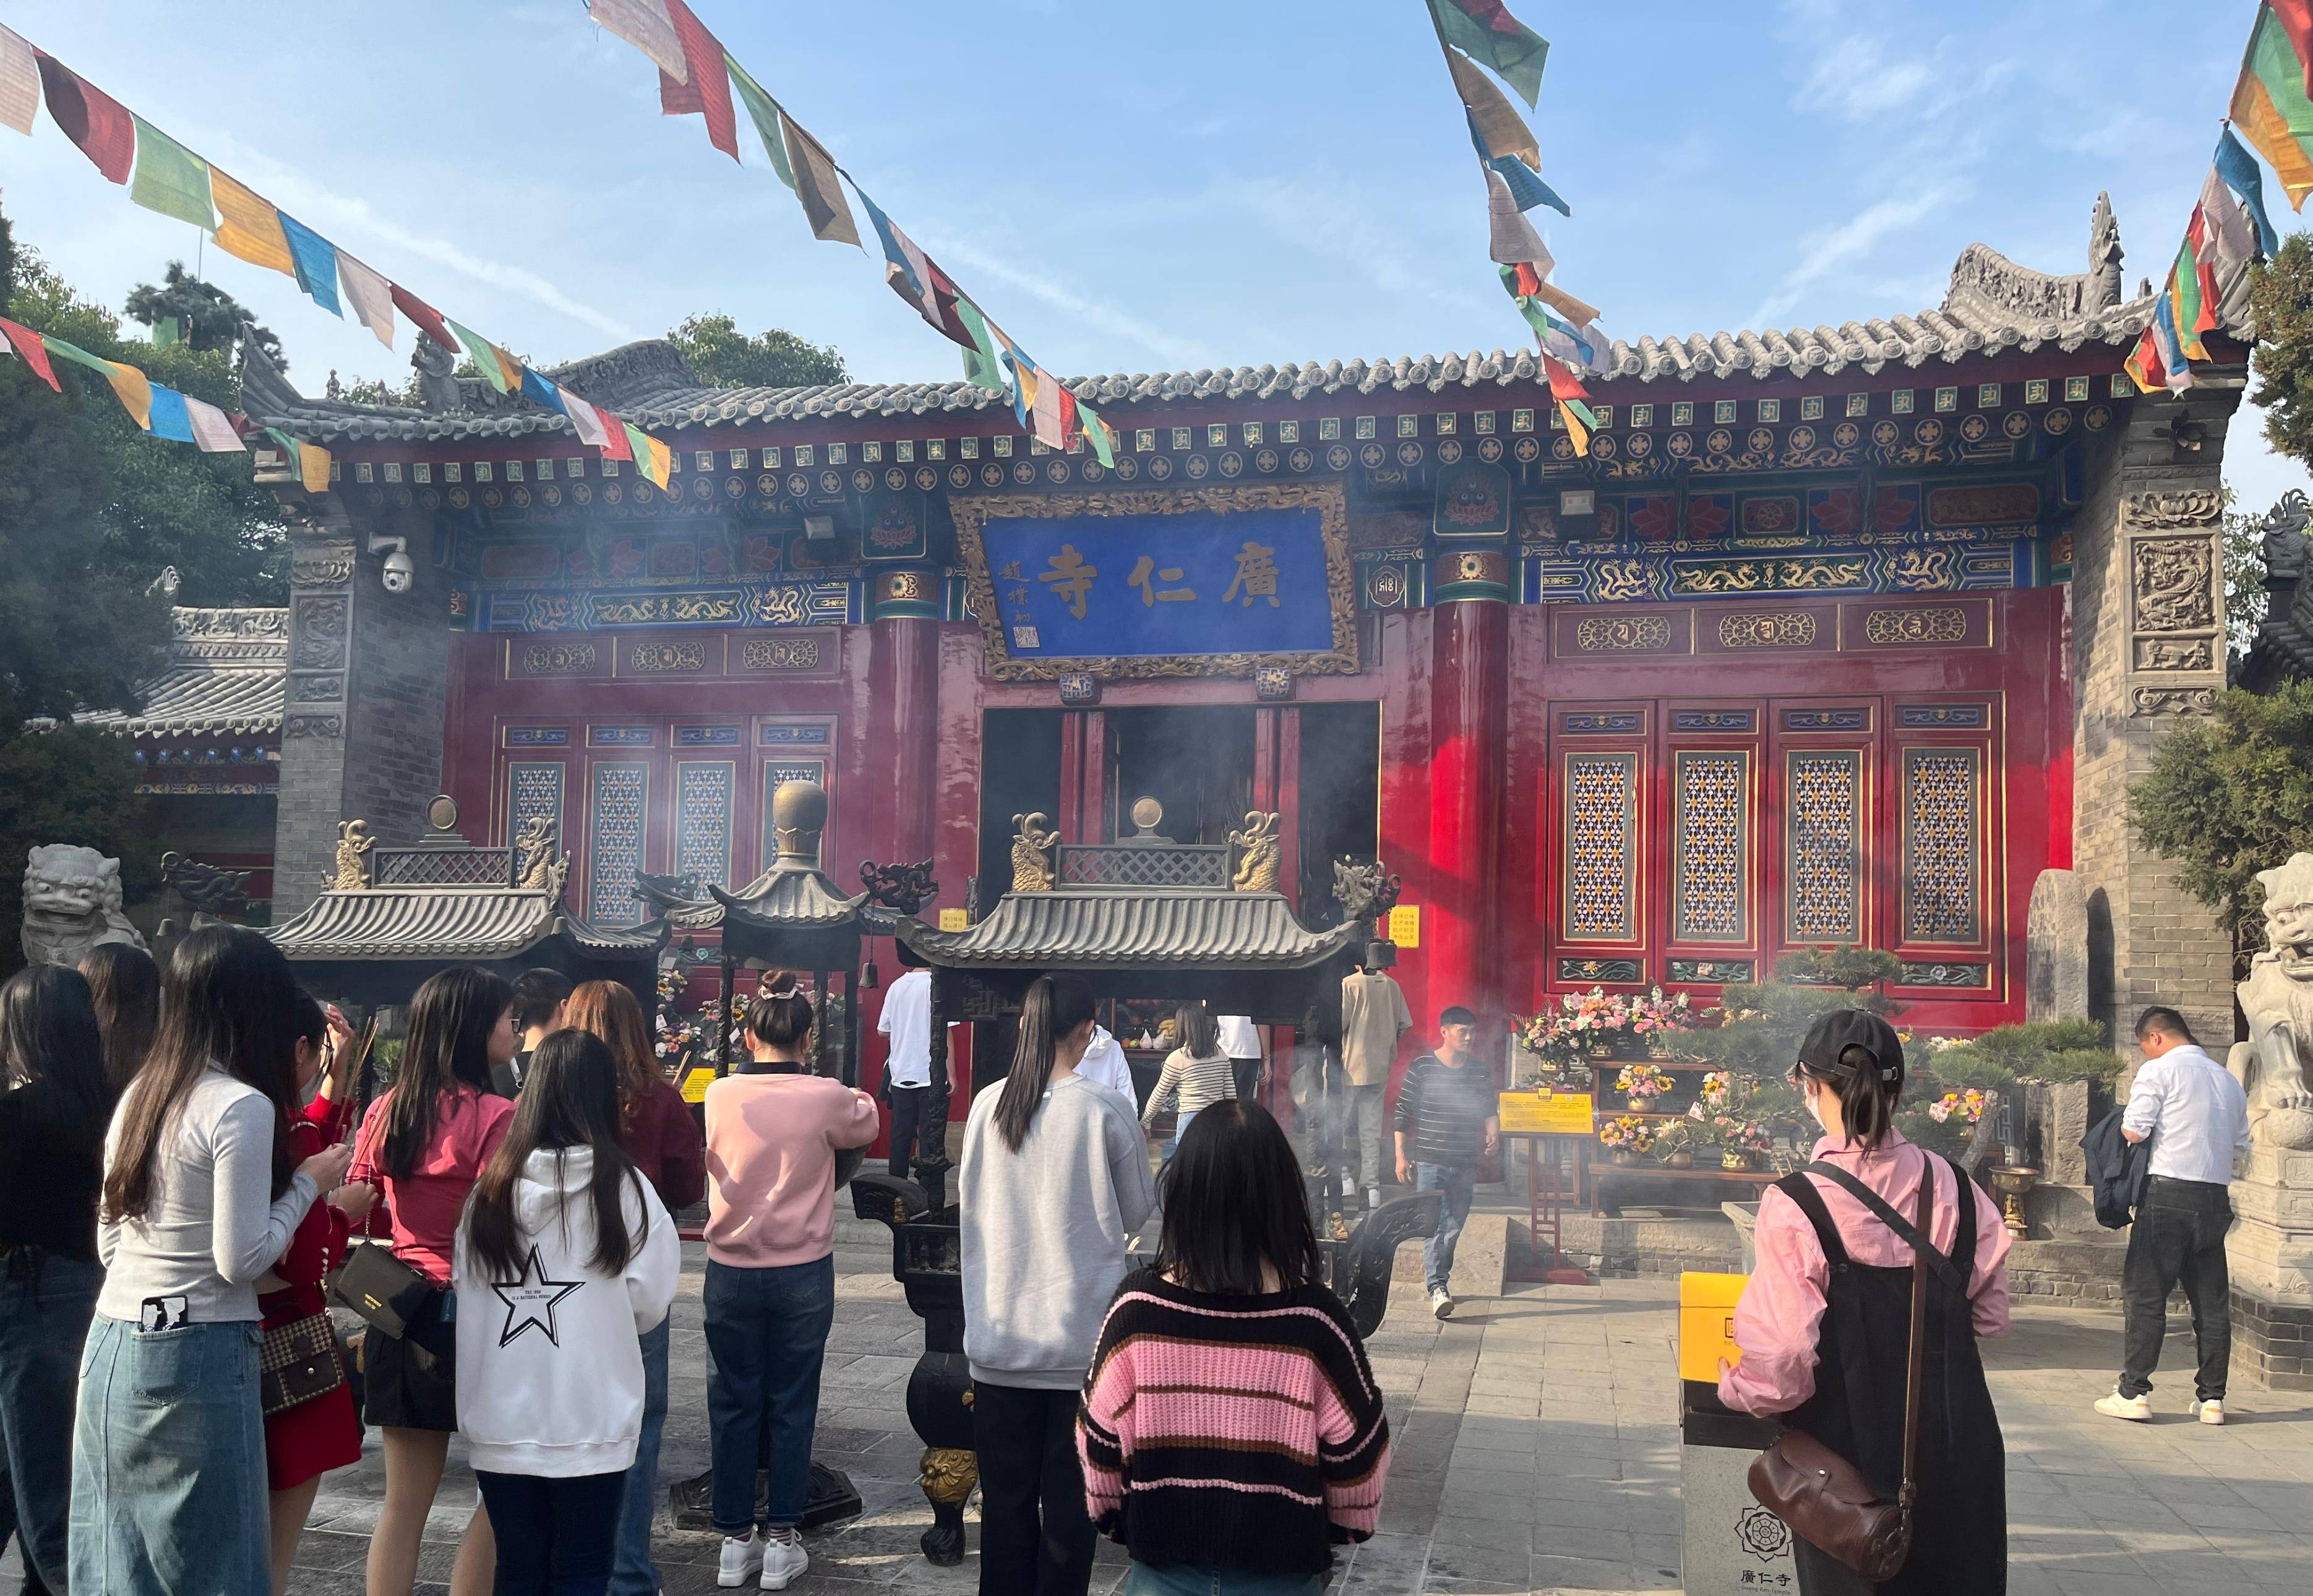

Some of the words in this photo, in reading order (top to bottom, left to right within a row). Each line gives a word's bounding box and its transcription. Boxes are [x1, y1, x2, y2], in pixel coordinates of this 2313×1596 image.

[1037, 542, 1281, 619] 廣仁寺
[1741, 1570, 1792, 1587] 廣仁寺
